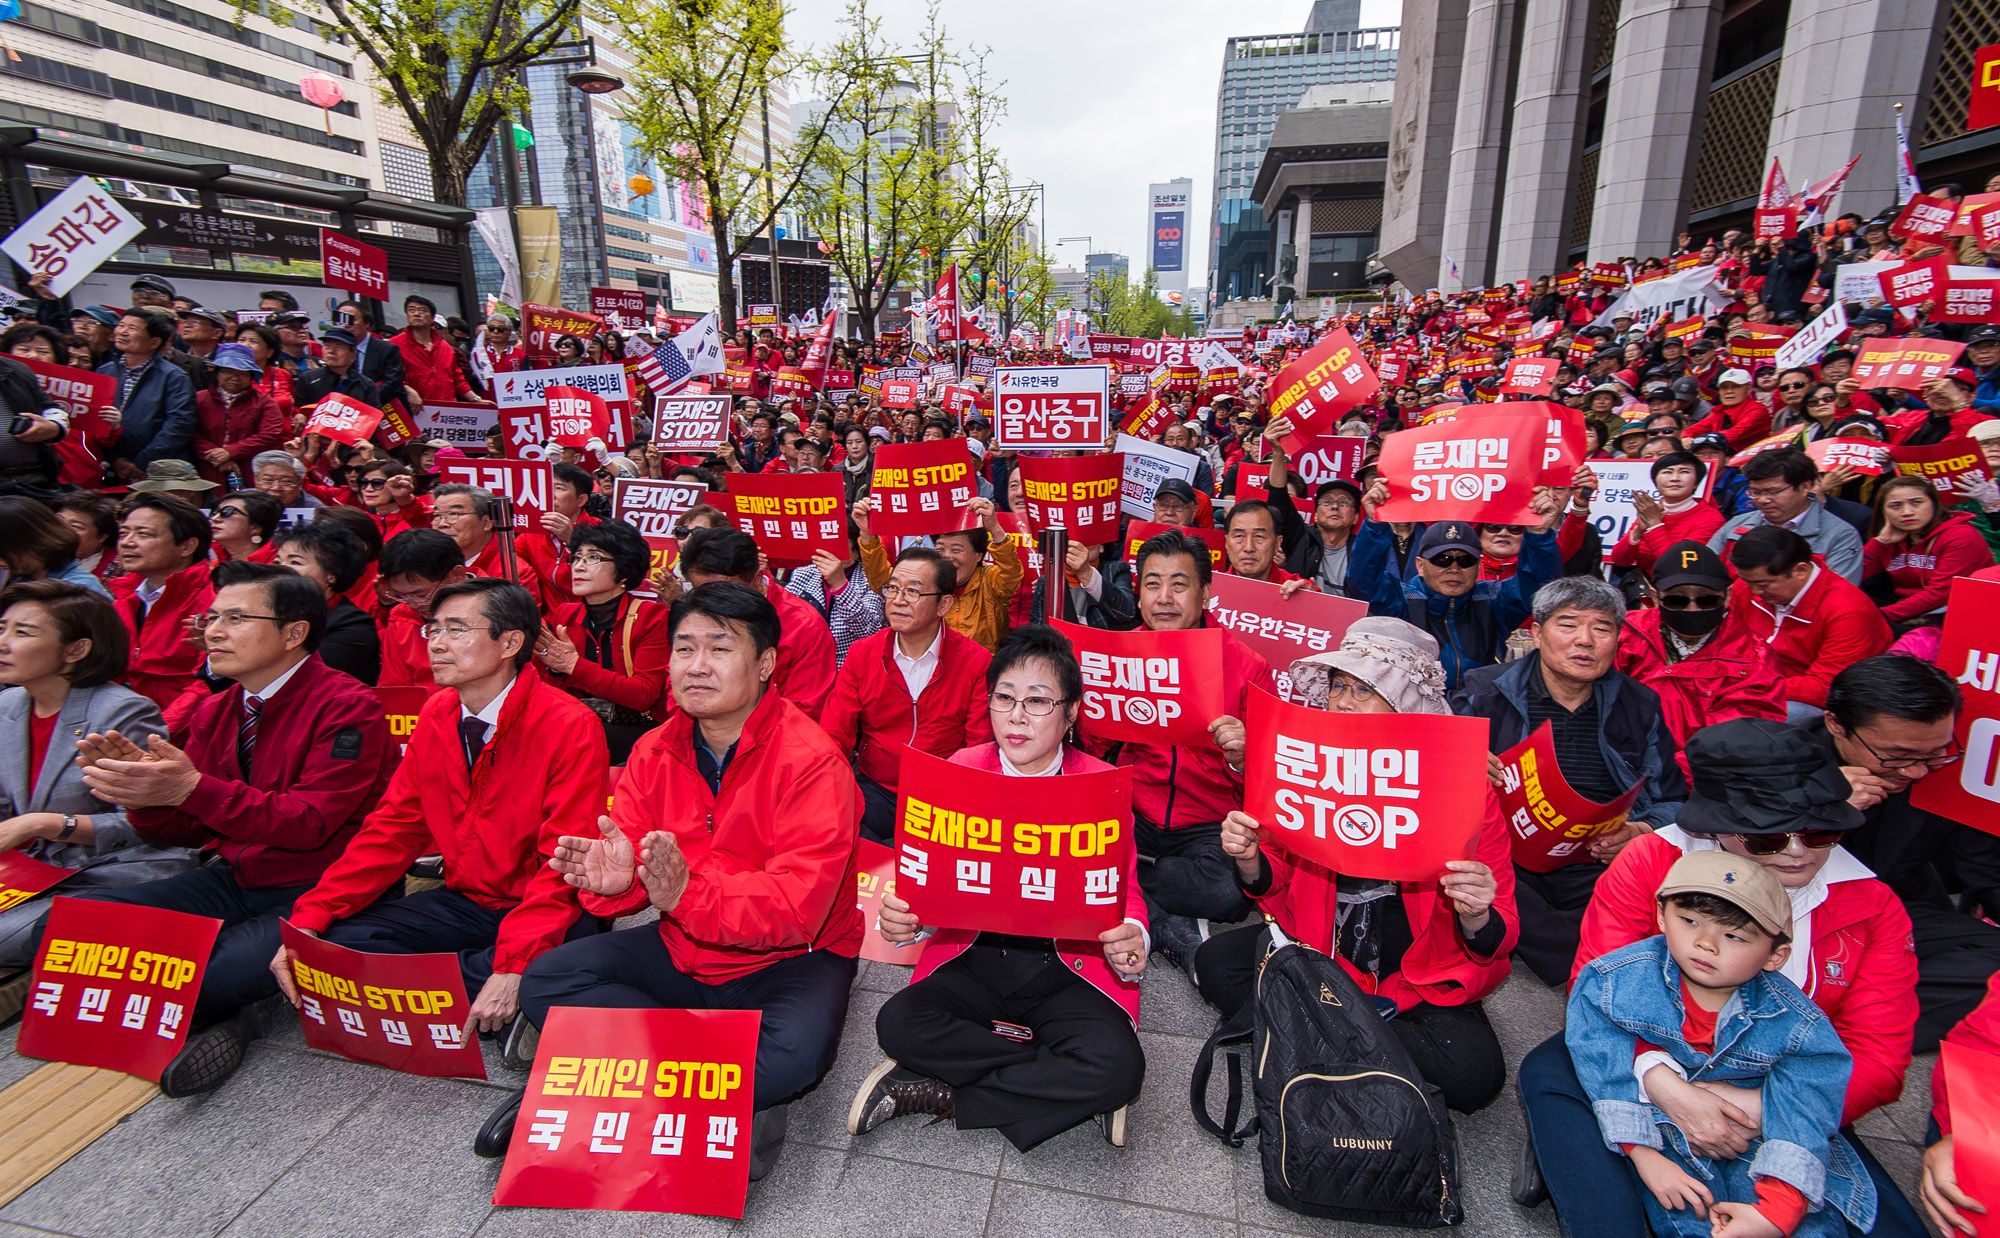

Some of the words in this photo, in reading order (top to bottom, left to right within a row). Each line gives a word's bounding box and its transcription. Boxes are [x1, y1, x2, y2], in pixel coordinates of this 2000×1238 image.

[1154, 194, 1186, 202] 조선일보
[178, 212, 257, 236] 세종문화회관
[1156, 227, 1181, 240] 100
[1903, 218, 1945, 235] STOP
[28, 194, 123, 278] 송파갑
[1892, 267, 1933, 289] 문재인
[1894, 281, 1935, 301] STOP
[1946, 288, 1993, 303] 문재인
[595, 297, 644, 310] 김포시(갑)
[1945, 303, 1992, 316] STOP
[564, 318, 597, 335] 희망!
[1780, 309, 1838, 364] 구리시
[1093, 343, 1112, 354] 포항
[1112, 343, 1130, 354] 북구
[1861, 351, 1903, 364] 문재인
[1902, 350, 1952, 363] STOP
[1011, 375, 1060, 388] 자유한국당
[1121, 384, 1146, 392] STOP!
[1270, 380, 1309, 418] 문재인
[1305, 347, 1352, 387] STOP
[1510, 376, 1541, 387] STOP
[549, 399, 592, 418] 문재인
[888, 394, 910, 403] STOP
[439, 415, 478, 425] 자유한국당
[661, 400, 725, 420] 문재인
[1002, 398, 1099, 439] 울산중구
[1140, 399, 1161, 421] STOP
[446, 427, 490, 443] 당원협의
[550, 418, 592, 437] STOP
[660, 421, 722, 440] STOP!
[1413, 438, 1509, 471] 문재인
[1922, 454, 1978, 475] STOP
[873, 467, 909, 488] 문재인
[912, 462, 967, 487] STOP
[1140, 458, 1170, 474] 자유한국당
[1024, 477, 1068, 502] 문재인
[1072, 477, 1119, 501] STOP
[1410, 473, 1507, 502] STOP
[622, 485, 699, 512] 문재인
[735, 495, 781, 516] 문재인
[784, 496, 838, 515] STOP
[1681, 551, 1698, 569] P
[1217, 608, 1333, 651] 자유한국당
[1080, 650, 1181, 695] 문재인
[1083, 690, 1182, 728] STOP
[1274, 733, 1420, 799] 문재인
[1519, 747, 1567, 831] 문재인
[903, 795, 1002, 854] 문재인
[1013, 818, 1120, 858] STOP
[1274, 789, 1420, 850] STOP
[43, 938, 130, 980] 문재인
[129, 950, 197, 991] STOP
[293, 958, 362, 1007] 문재인
[363, 985, 454, 1015] STOP
[541, 1056, 649, 1099] 문재인
[653, 1060, 742, 1101] STOP
[1333, 1137, 1393, 1150] LUBUNNY
